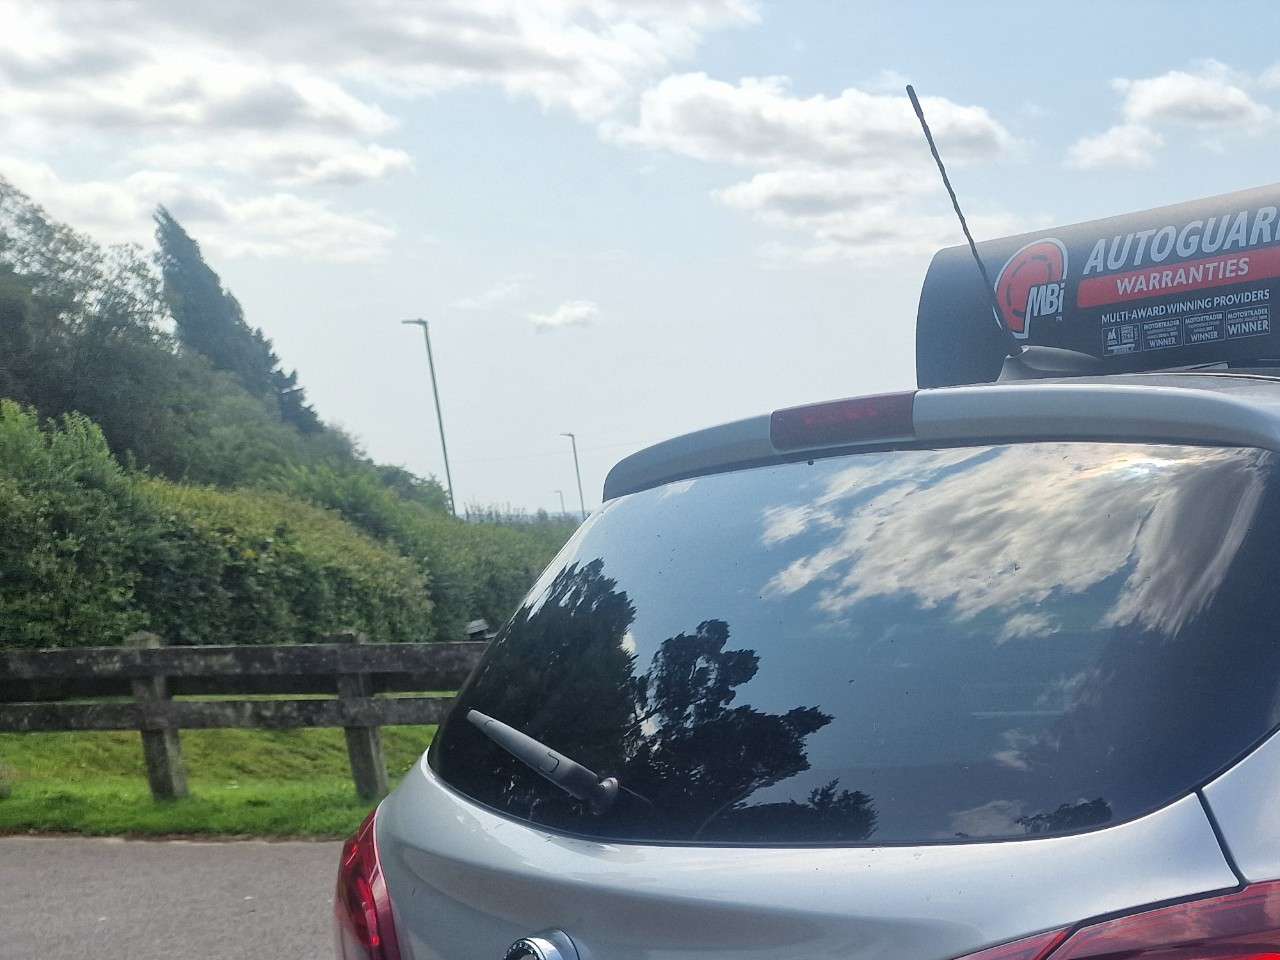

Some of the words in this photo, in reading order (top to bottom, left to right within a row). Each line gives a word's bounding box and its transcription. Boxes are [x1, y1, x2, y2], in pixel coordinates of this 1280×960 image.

[1116, 257, 1250, 296] WARRANTIES
[1029, 282, 1065, 317] MBi
[1101, 305, 1166, 325] MULTI-AWARD
[1167, 297, 1212, 313] WINNING
[1213, 289, 1270, 307] PROVIDERS
[1190, 331, 1218, 342] WINNER
[1227, 319, 1269, 336] WINNER
[1149, 337, 1176, 348] WINNER
